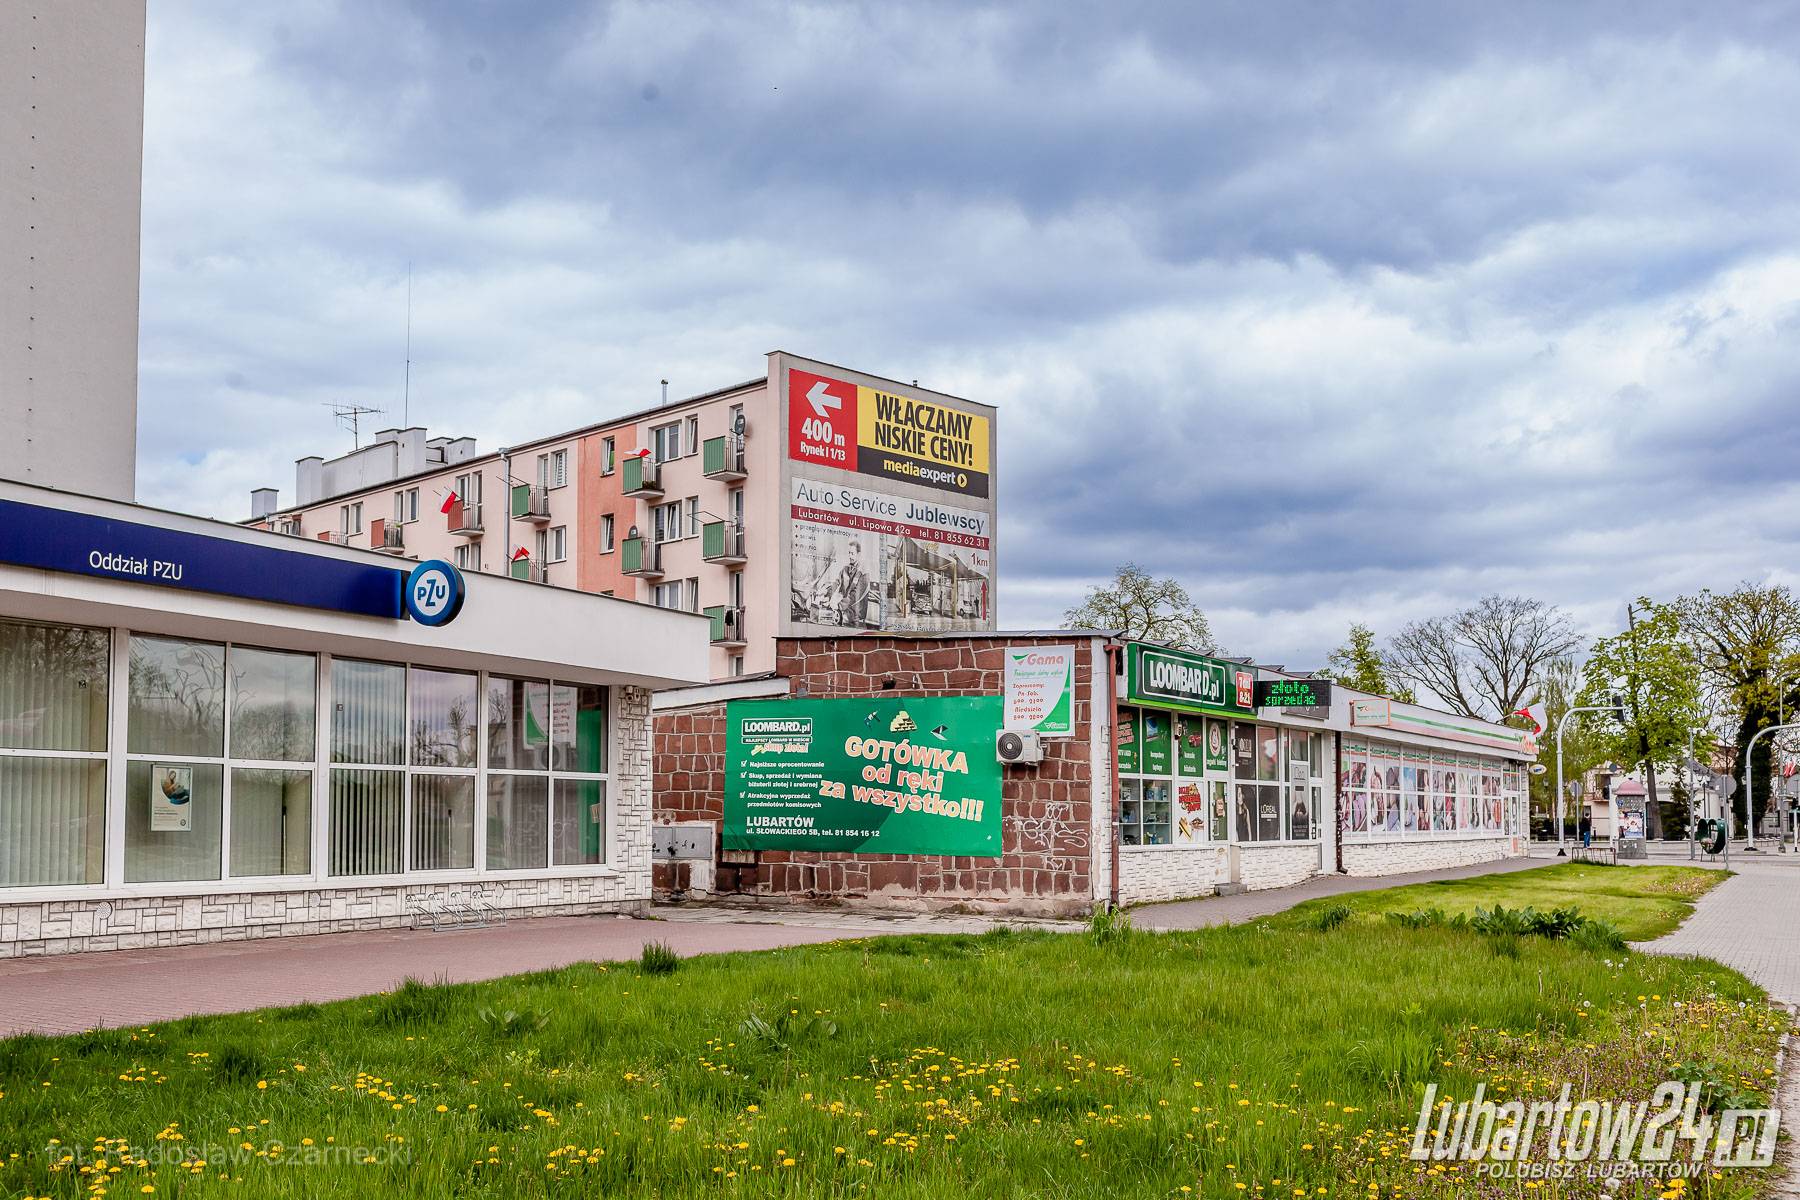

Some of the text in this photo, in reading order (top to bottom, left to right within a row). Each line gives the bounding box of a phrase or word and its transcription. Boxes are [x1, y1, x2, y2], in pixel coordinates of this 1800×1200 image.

[875, 392, 972, 440] WŁĄCZAMY
[801, 417, 845, 446] 400 m
[875, 422, 972, 466] NISKIE CENY!
[800, 441, 824, 456] Rynek
[830, 448, 846, 461] 1/13
[883, 459, 956, 485] mediaexpert
[798, 508, 985, 548] Lubartów ul. Lipowa 42a tel. 81 855 62 31
[906, 504, 984, 535] Jublewscy
[89, 550, 182, 580] Oddział PZU
[971, 552, 988, 567] 1km
[417, 579, 446, 606] PZU
[1027, 654, 1064, 666] Gama
[1150, 660, 1220, 700] LOOMBARD.pl
[1272, 679, 1310, 694] złoto
[1265, 692, 1316, 706] sprzedaż
[744, 722, 810, 733] LOOMBARD.pl
[844, 736, 968, 774] GOTÓWKA
[748, 772, 764, 780] Skup,
[862, 764, 944, 794] od ręki
[818, 780, 984, 822] za wszystko!!!
[746, 815, 814, 828] LUBARTÓW
[756, 828, 808, 836] SŁOWACKIEGO
